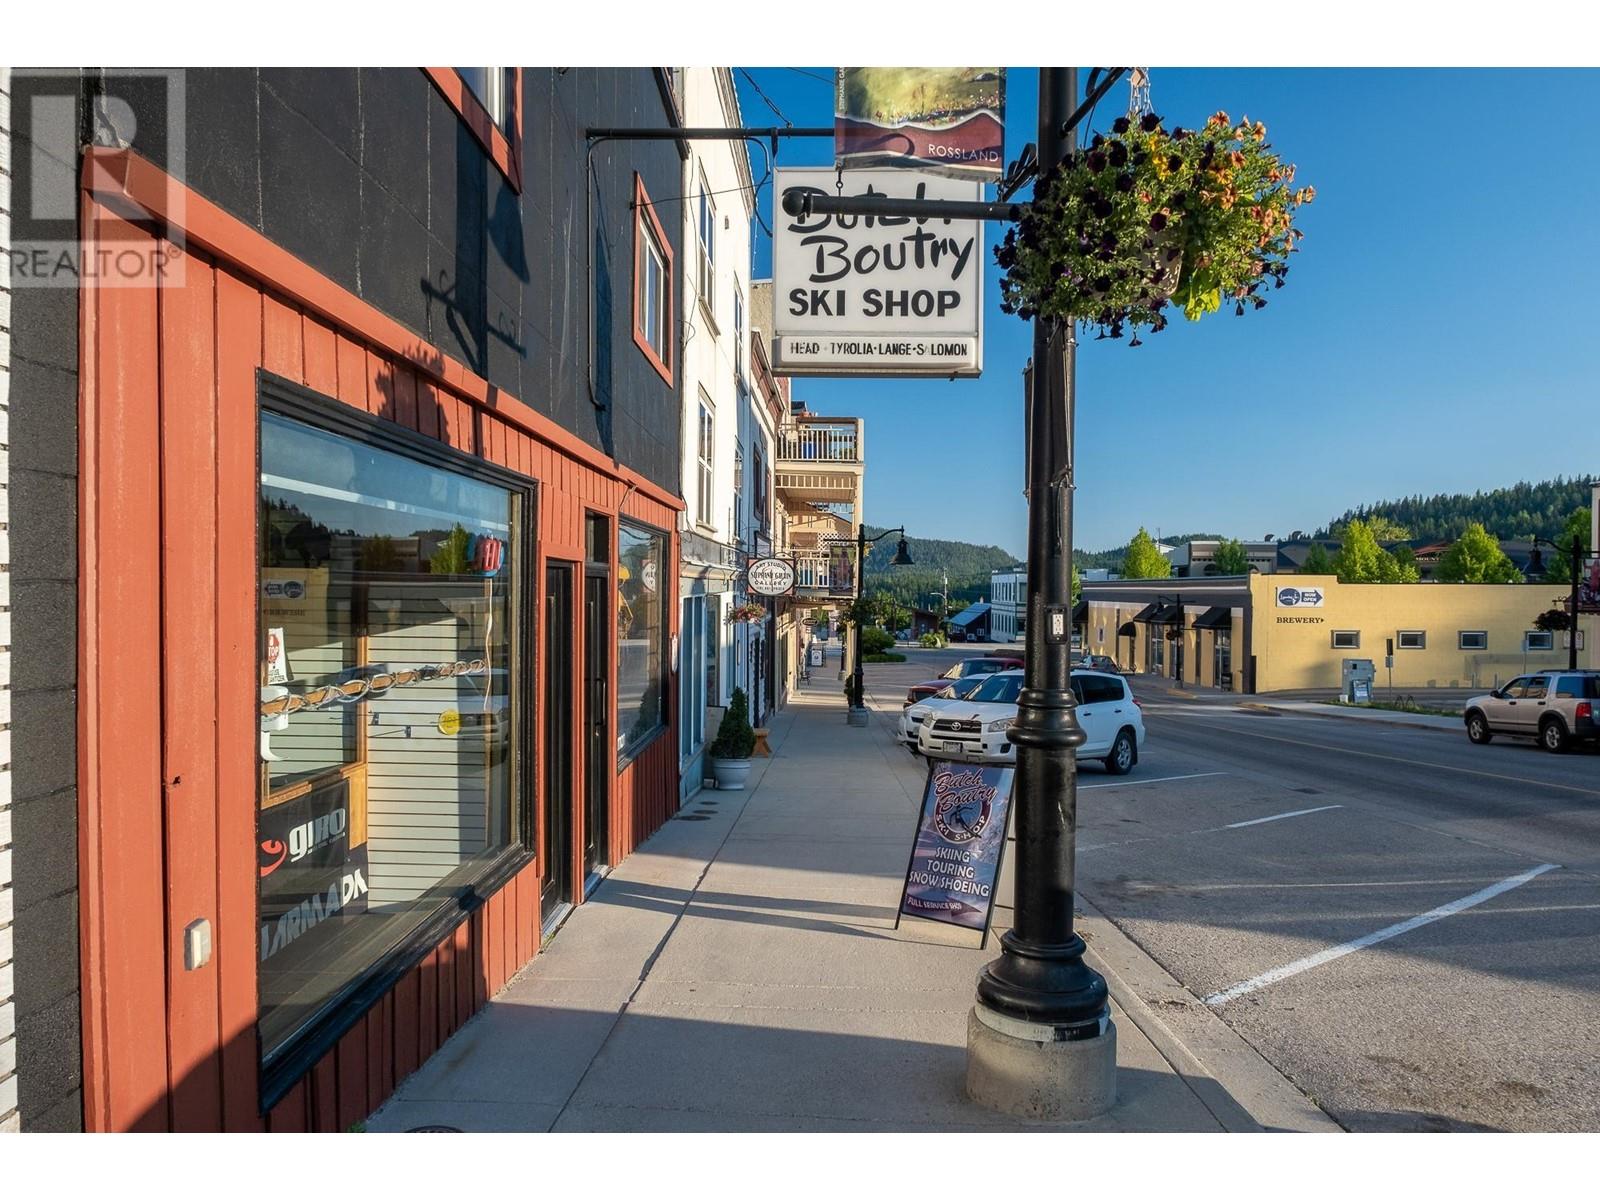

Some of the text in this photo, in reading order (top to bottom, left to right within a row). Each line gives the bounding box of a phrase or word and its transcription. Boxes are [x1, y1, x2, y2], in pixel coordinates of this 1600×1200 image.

[928, 143, 999, 162] ROSSLAND
[788, 287, 961, 317] SKI SHOP
[791, 342, 820, 355] HEAD
[1276, 616, 1320, 624] BREWERY
[936, 847, 970, 863] SKIING
[927, 859, 974, 879] TOURING
[940, 877, 990, 897] SHOEING
